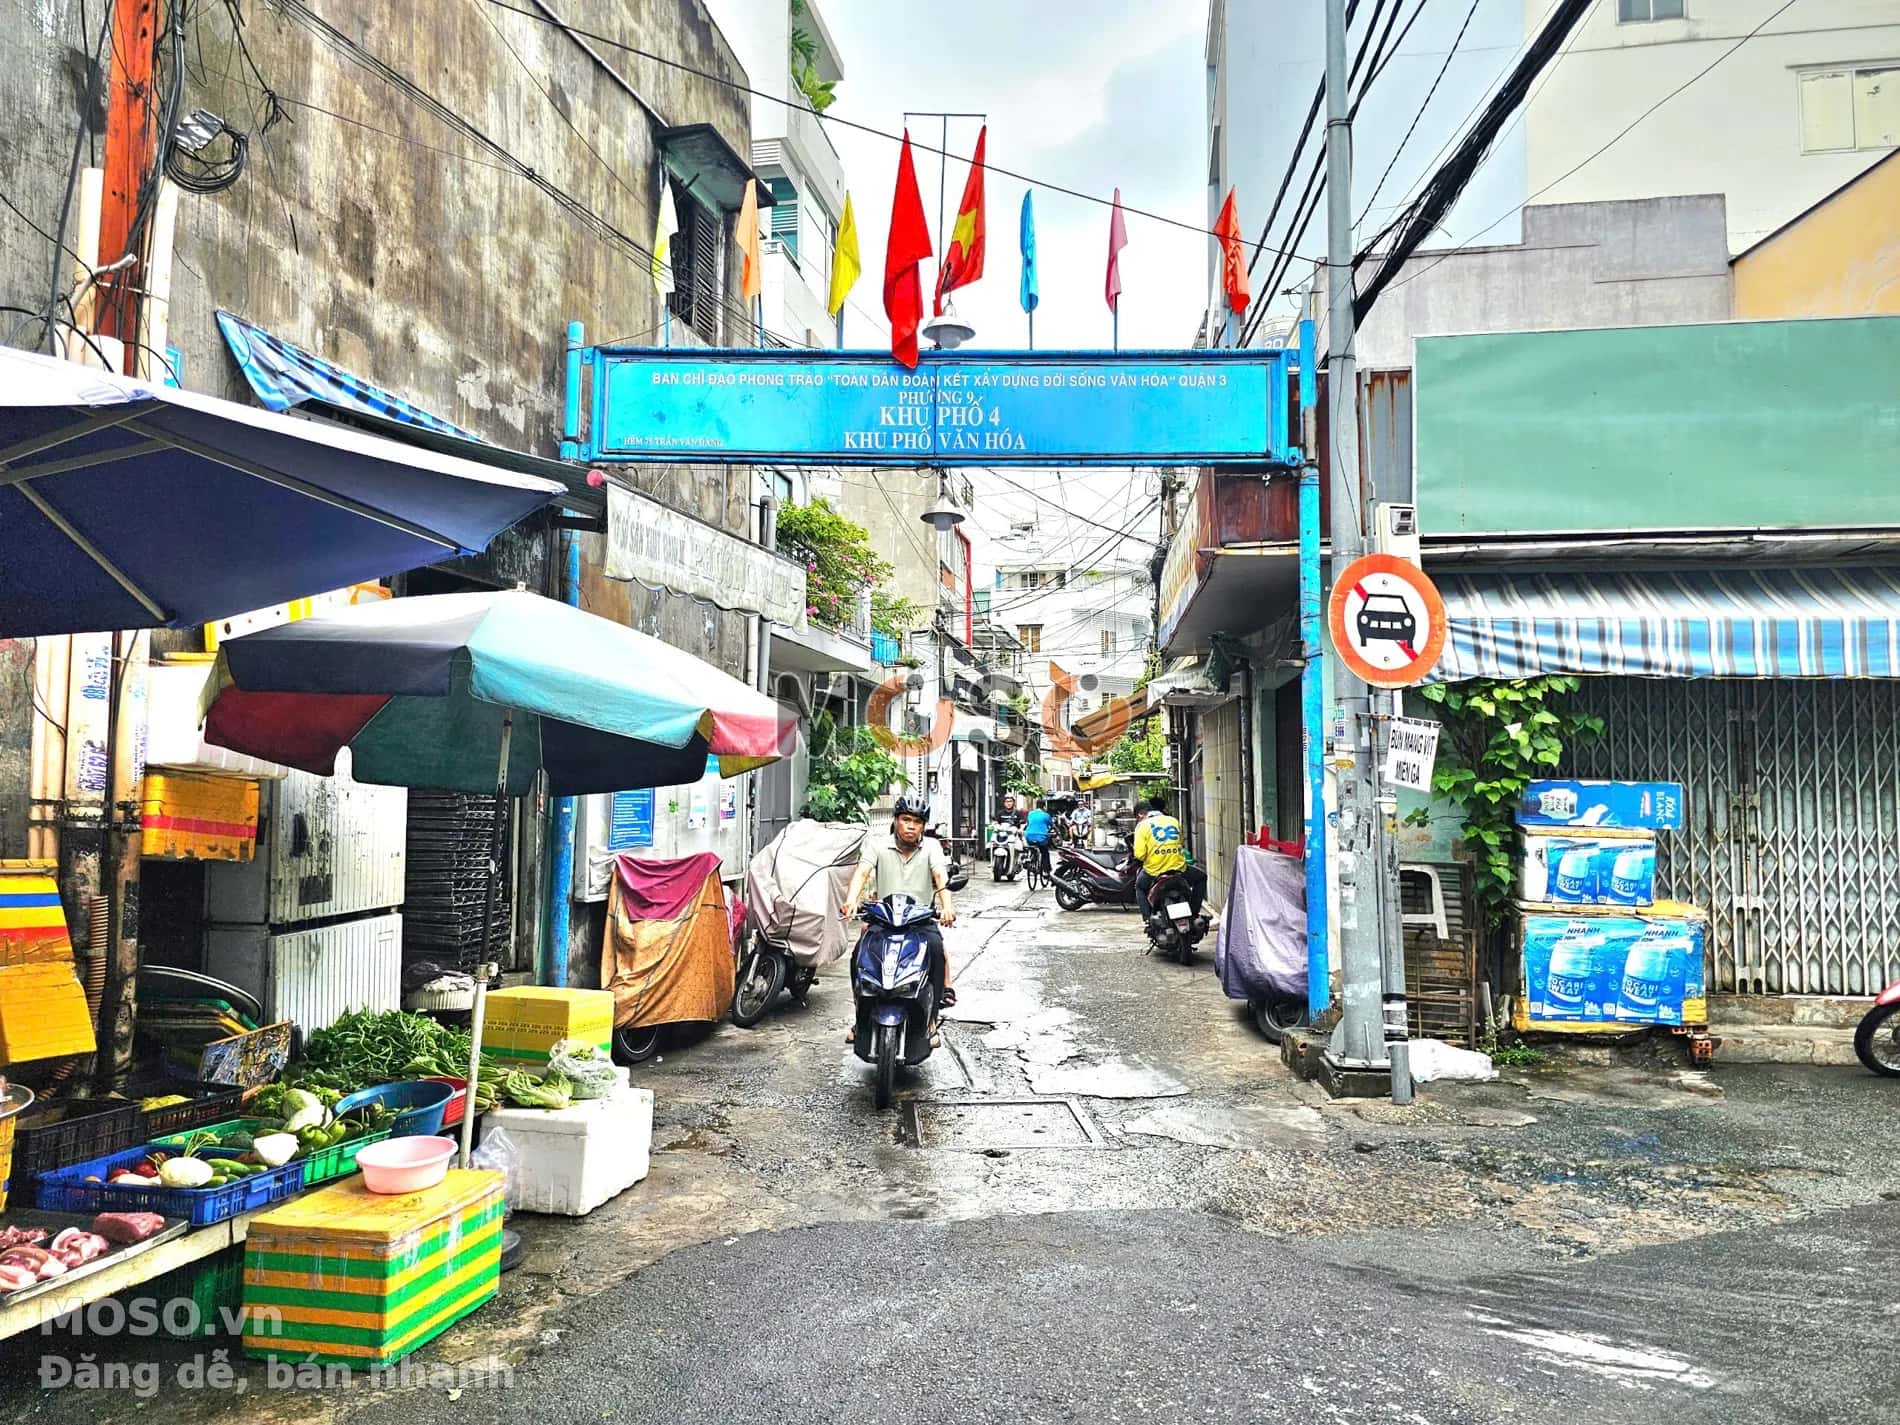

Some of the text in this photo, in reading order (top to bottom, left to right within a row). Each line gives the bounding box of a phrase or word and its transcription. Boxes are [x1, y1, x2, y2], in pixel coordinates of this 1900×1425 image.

[652, 372, 679, 385] BAN
[739, 374, 784, 386] PHONG
[943, 370, 969, 387] KẾT
[1219, 375, 1227, 386] 3
[880, 396, 1001, 426] KHU PHỐ 4
[844, 425, 1027, 450] KHU PHỐ VĂN HÓA
